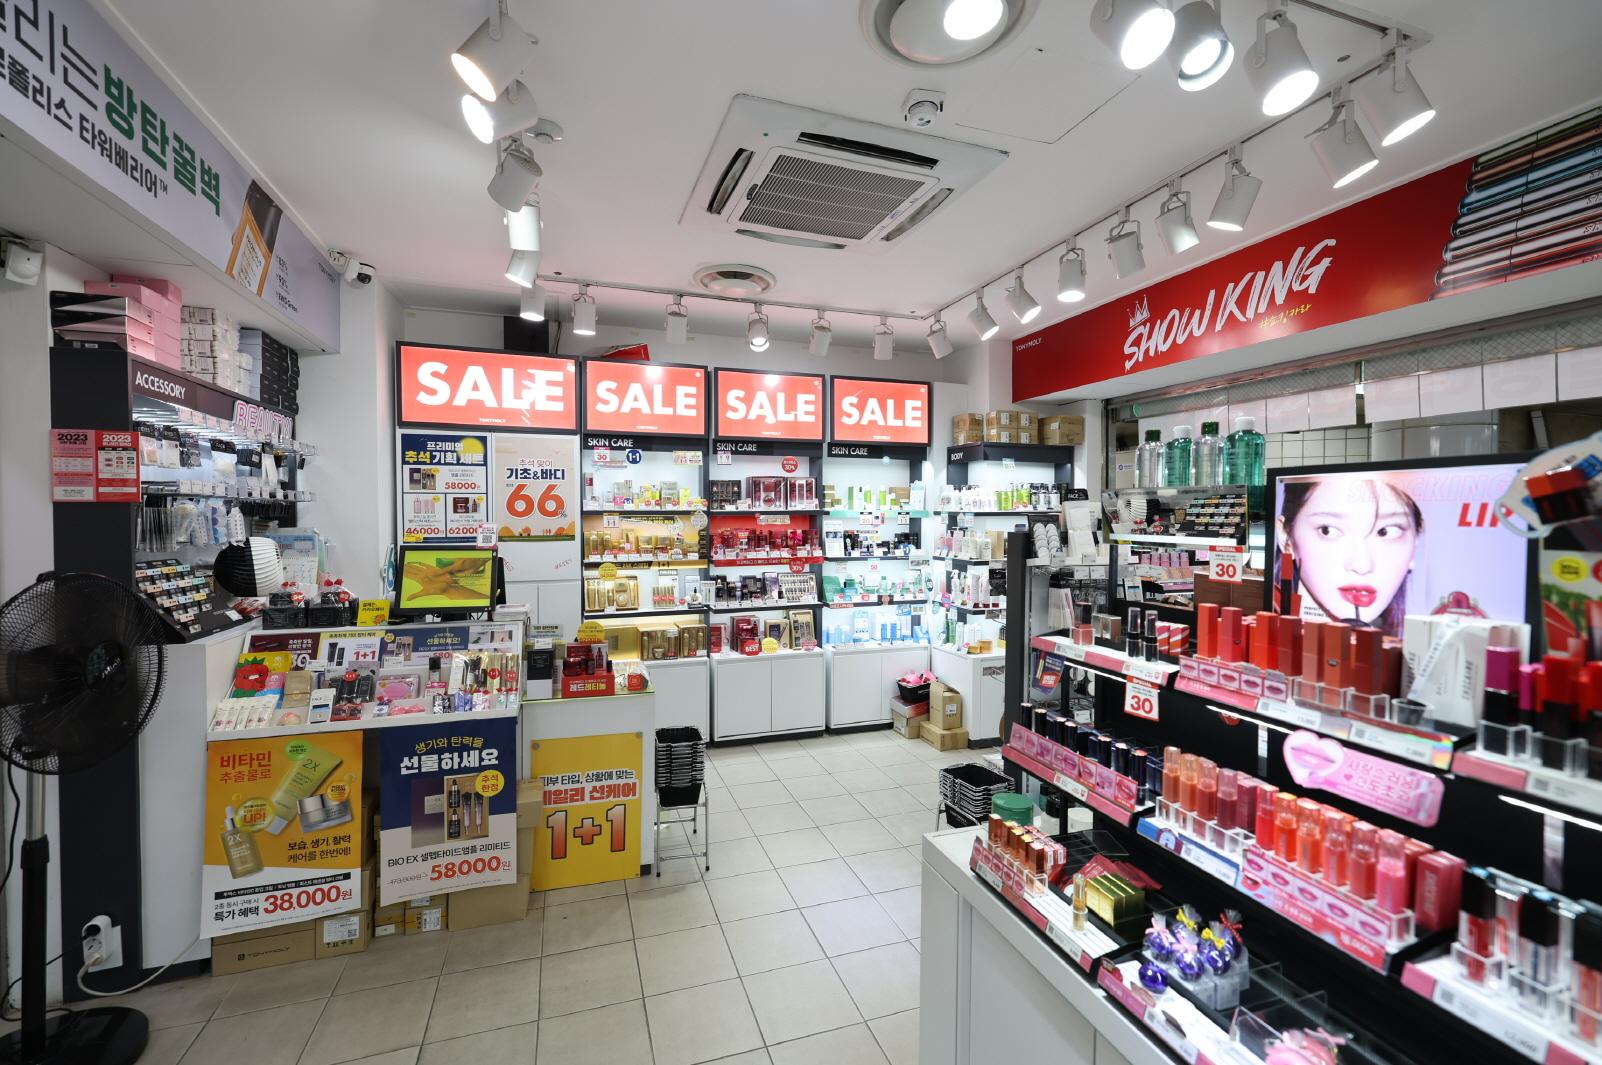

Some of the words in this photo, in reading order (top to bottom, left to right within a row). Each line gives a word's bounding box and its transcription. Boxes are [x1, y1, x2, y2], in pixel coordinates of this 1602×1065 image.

[1122, 289, 1216, 373] SHOW
[1214, 238, 1337, 334] KING
[135, 371, 187, 399] ACCESSORY
[416, 361, 565, 412] SALE
[595, 380, 698, 417] SALE
[725, 389, 816, 423] SALE
[841, 395, 922, 427] SALE
[57, 433, 89, 442] 2023
[103, 434, 132, 442] 2023
[588, 438, 608, 446] SKIN
[611, 438, 634, 447] CARE
[716, 443, 735, 451] SKIN
[738, 444, 757, 452] CARE
[851, 447, 868, 455] CARE
[951, 451, 964, 461] BODY
[404, 451, 431, 463] 추석
[597, 453, 607, 461] 30
[506, 467, 565, 480] 기초&바디
[1215, 562, 1238, 579] 30
[353, 651, 377, 661] 1+1
[1130, 695, 1154, 715] 30
[414, 737, 448, 754] 생기와
[450, 736, 484, 749] 탄력을
[220, 750, 272, 770] 비타민
[400, 748, 499, 775] 선물하세요
[219, 769, 272, 784] 추출물로
[481, 774, 499, 783] 추석
[561, 774, 583, 785] 타입,
[585, 770, 613, 783] 상황에
[615, 769, 635, 780] 맞는
[589, 782, 637, 801] 선케어
[333, 834, 351, 845] 활력
[546, 803, 627, 860] 1+1
[288, 851, 318, 863] 케어를
[320, 846, 351, 859] 한번에!
[387, 858, 405, 867] BIO
[406, 855, 419, 864] EX
[479, 842, 511, 852] 리미티드
[226, 899, 240, 909] 동시
[214, 908, 236, 922] 특가
[238, 905, 260, 918] 혜택
